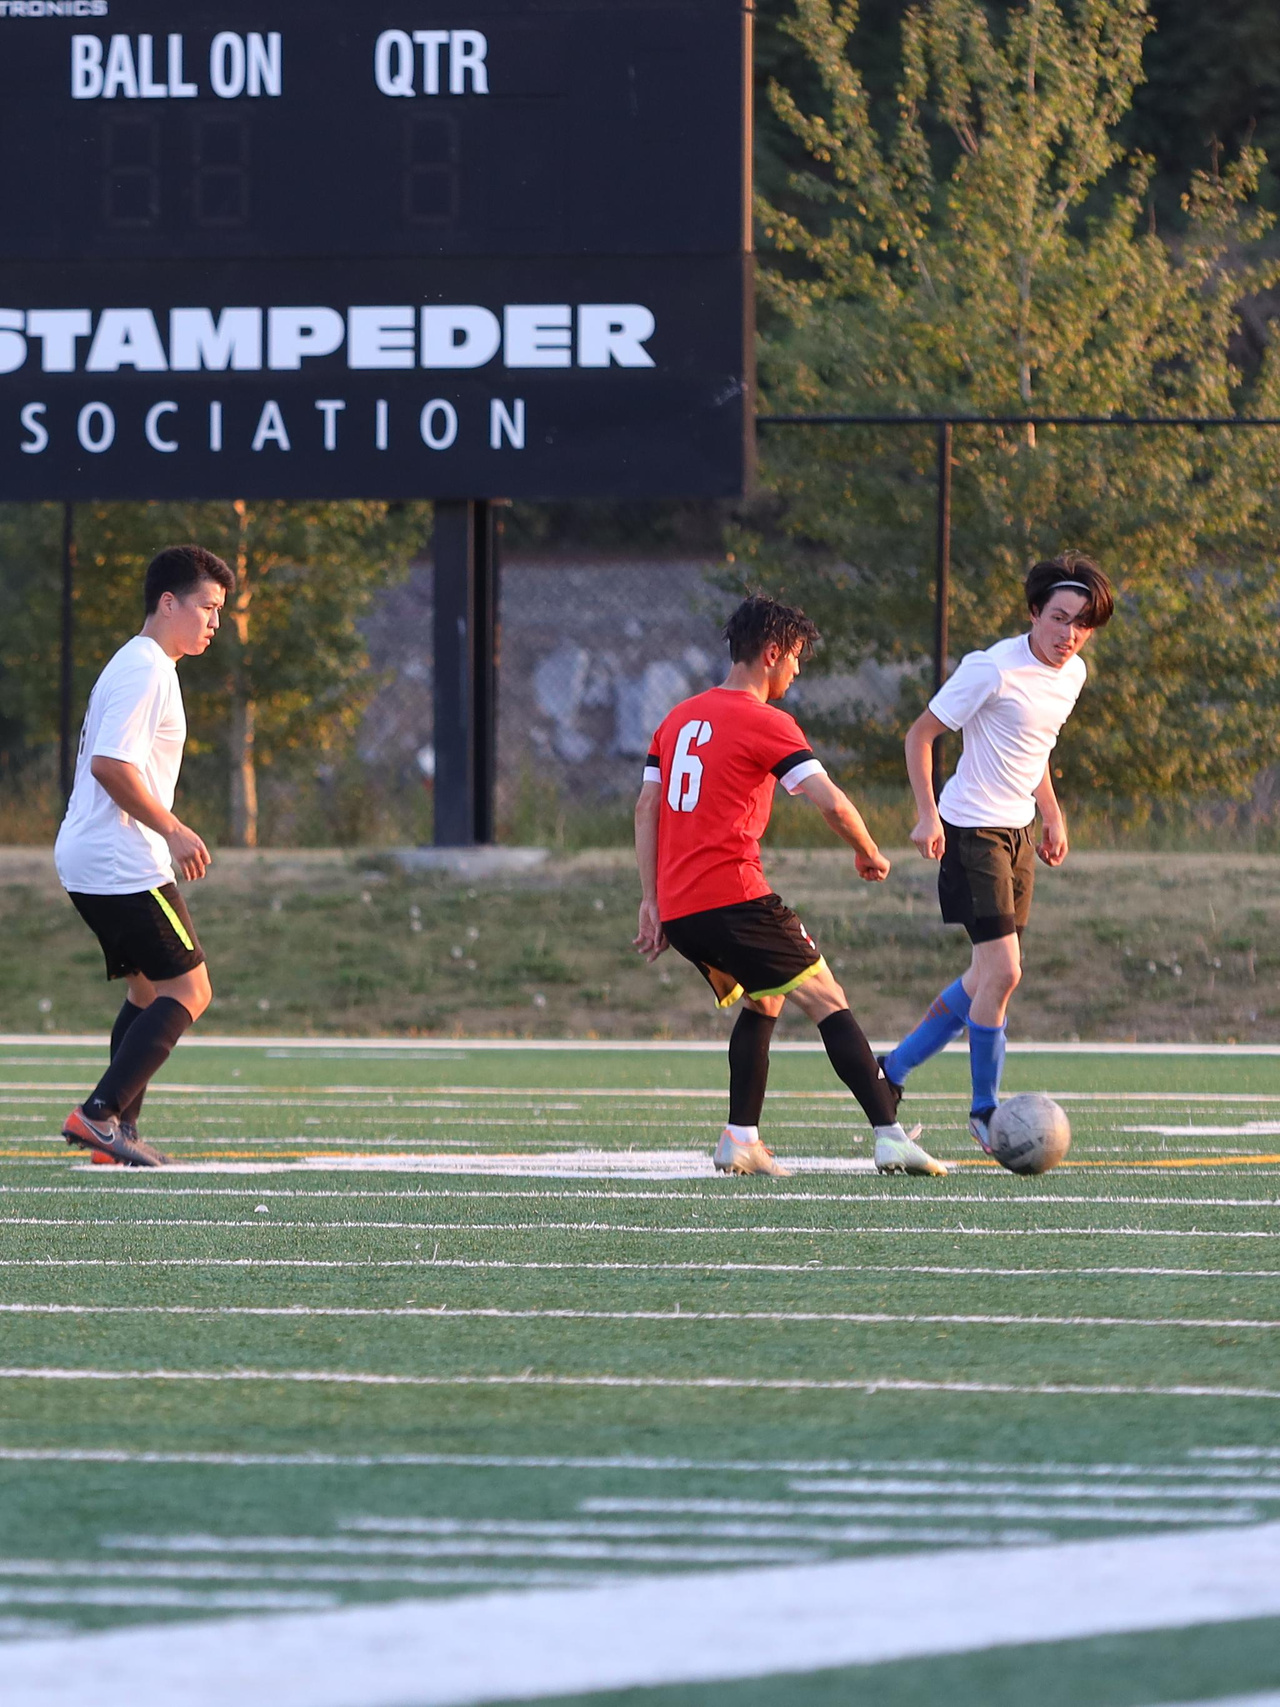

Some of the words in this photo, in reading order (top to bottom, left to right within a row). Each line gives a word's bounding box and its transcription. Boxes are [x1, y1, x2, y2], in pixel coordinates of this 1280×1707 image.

[71, 34, 198, 98] BALL
[210, 32, 282, 97] ON
[375, 30, 489, 96] QTR
[667, 719, 714, 813] 6
